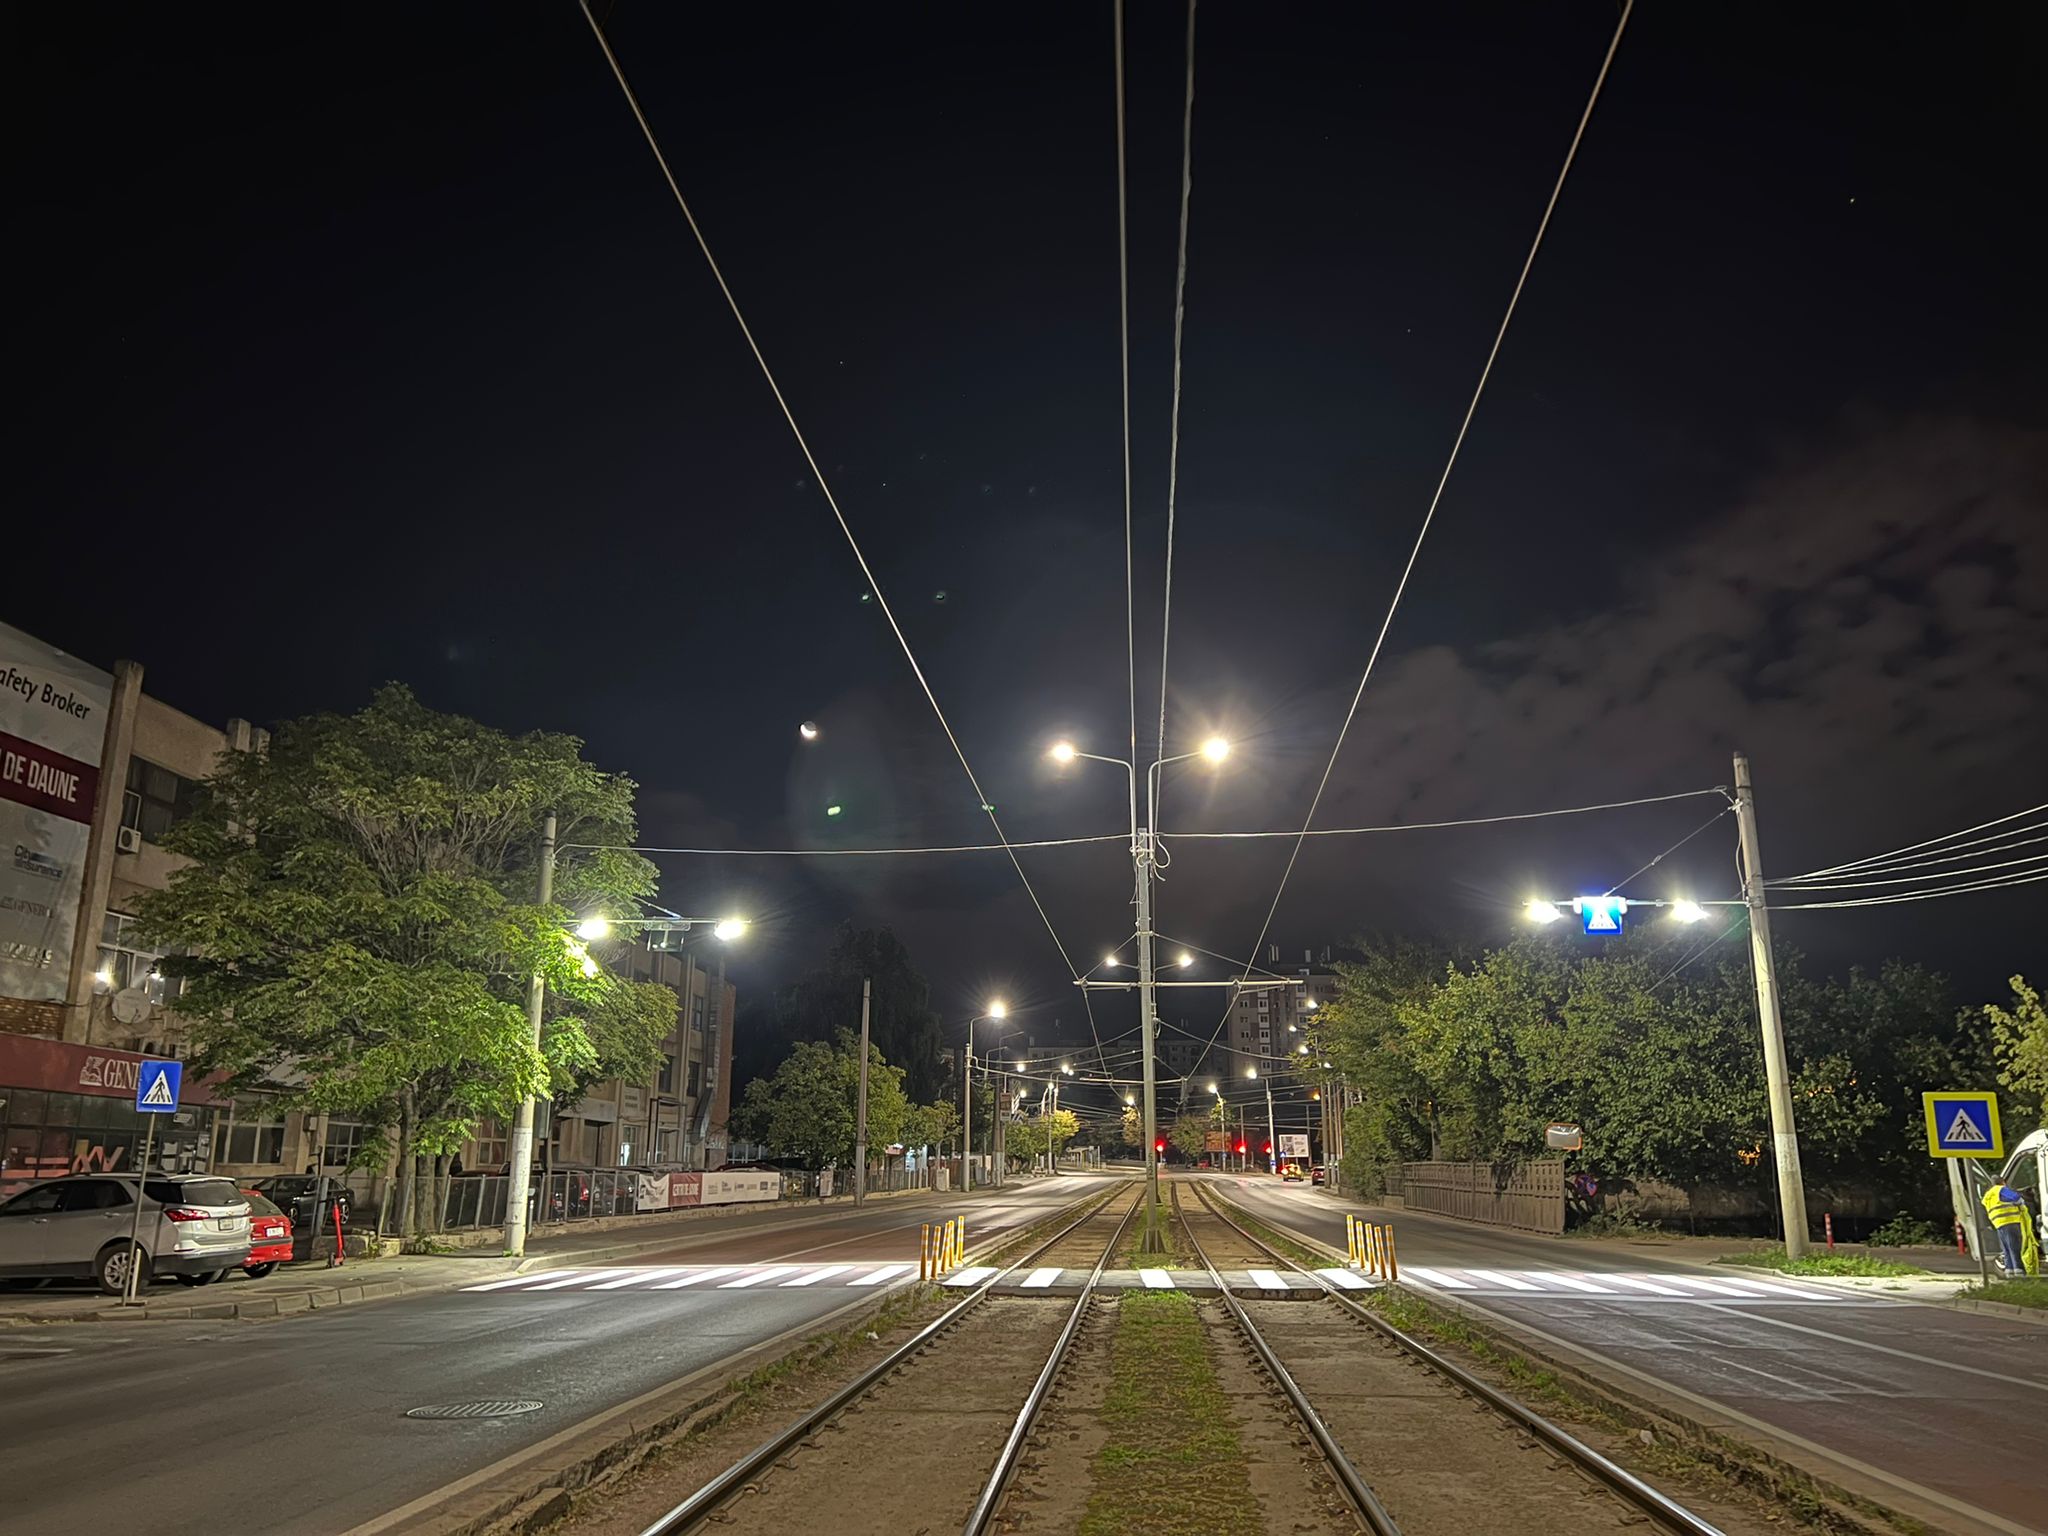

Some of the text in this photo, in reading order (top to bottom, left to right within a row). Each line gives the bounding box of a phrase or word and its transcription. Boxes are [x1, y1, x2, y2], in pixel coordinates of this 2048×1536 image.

[41, 683, 91, 720] Broker
[2, 751, 80, 803] DE DAUNE
